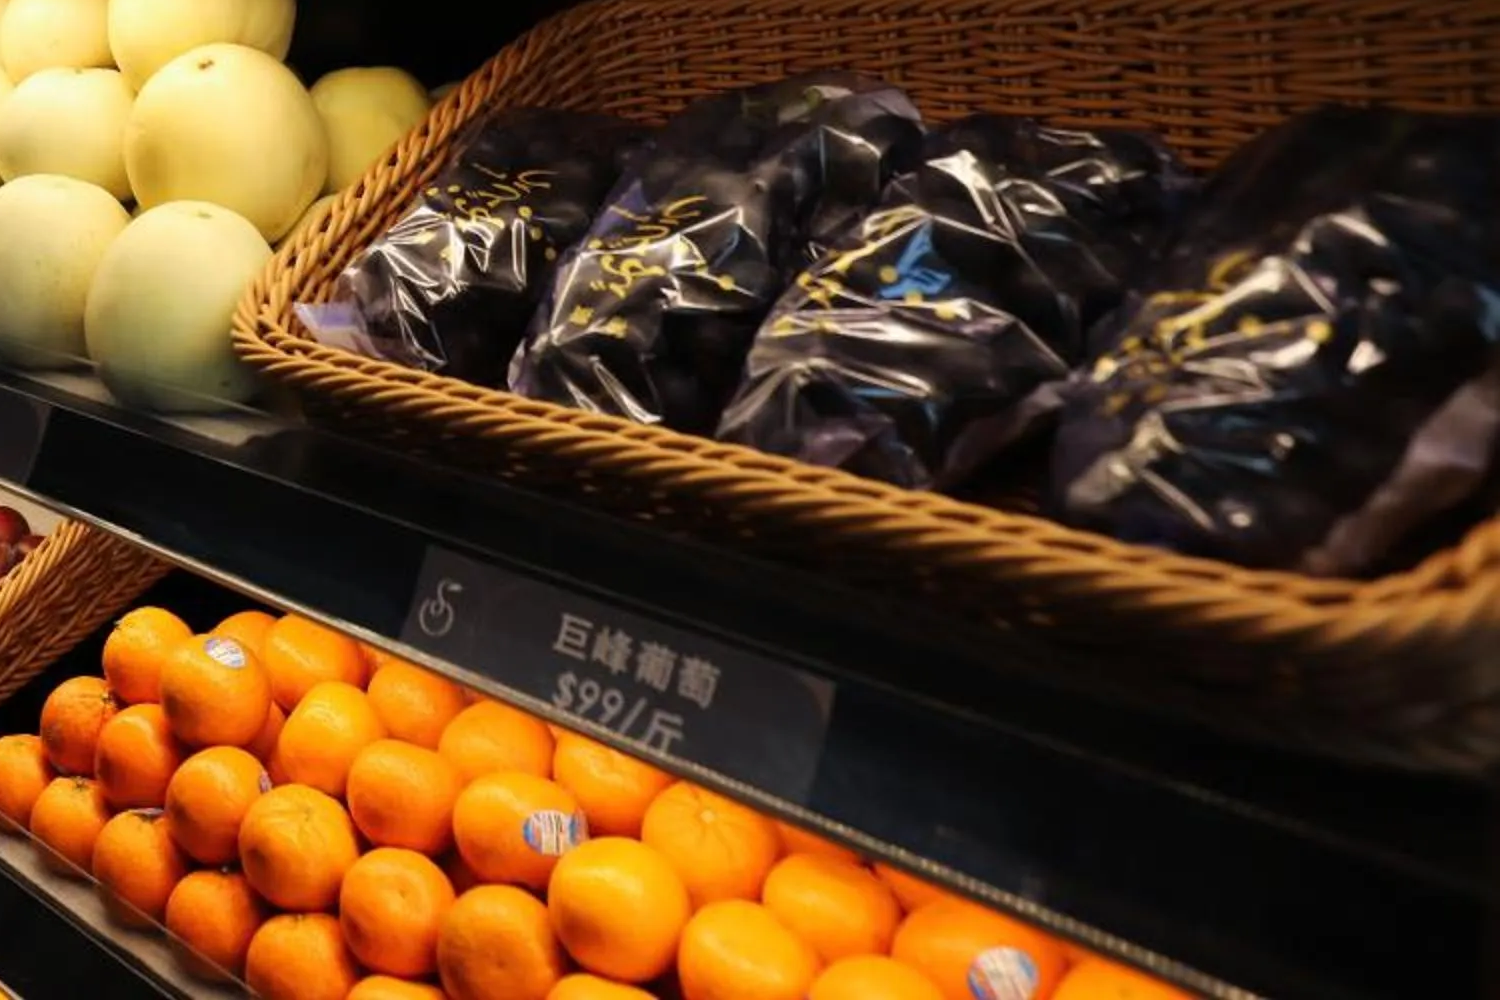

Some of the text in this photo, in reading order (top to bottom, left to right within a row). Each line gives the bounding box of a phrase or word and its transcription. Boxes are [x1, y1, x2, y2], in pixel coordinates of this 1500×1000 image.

[552, 611, 723, 710] 巨峰葡萄
[552, 671, 686, 758] $99/斤
